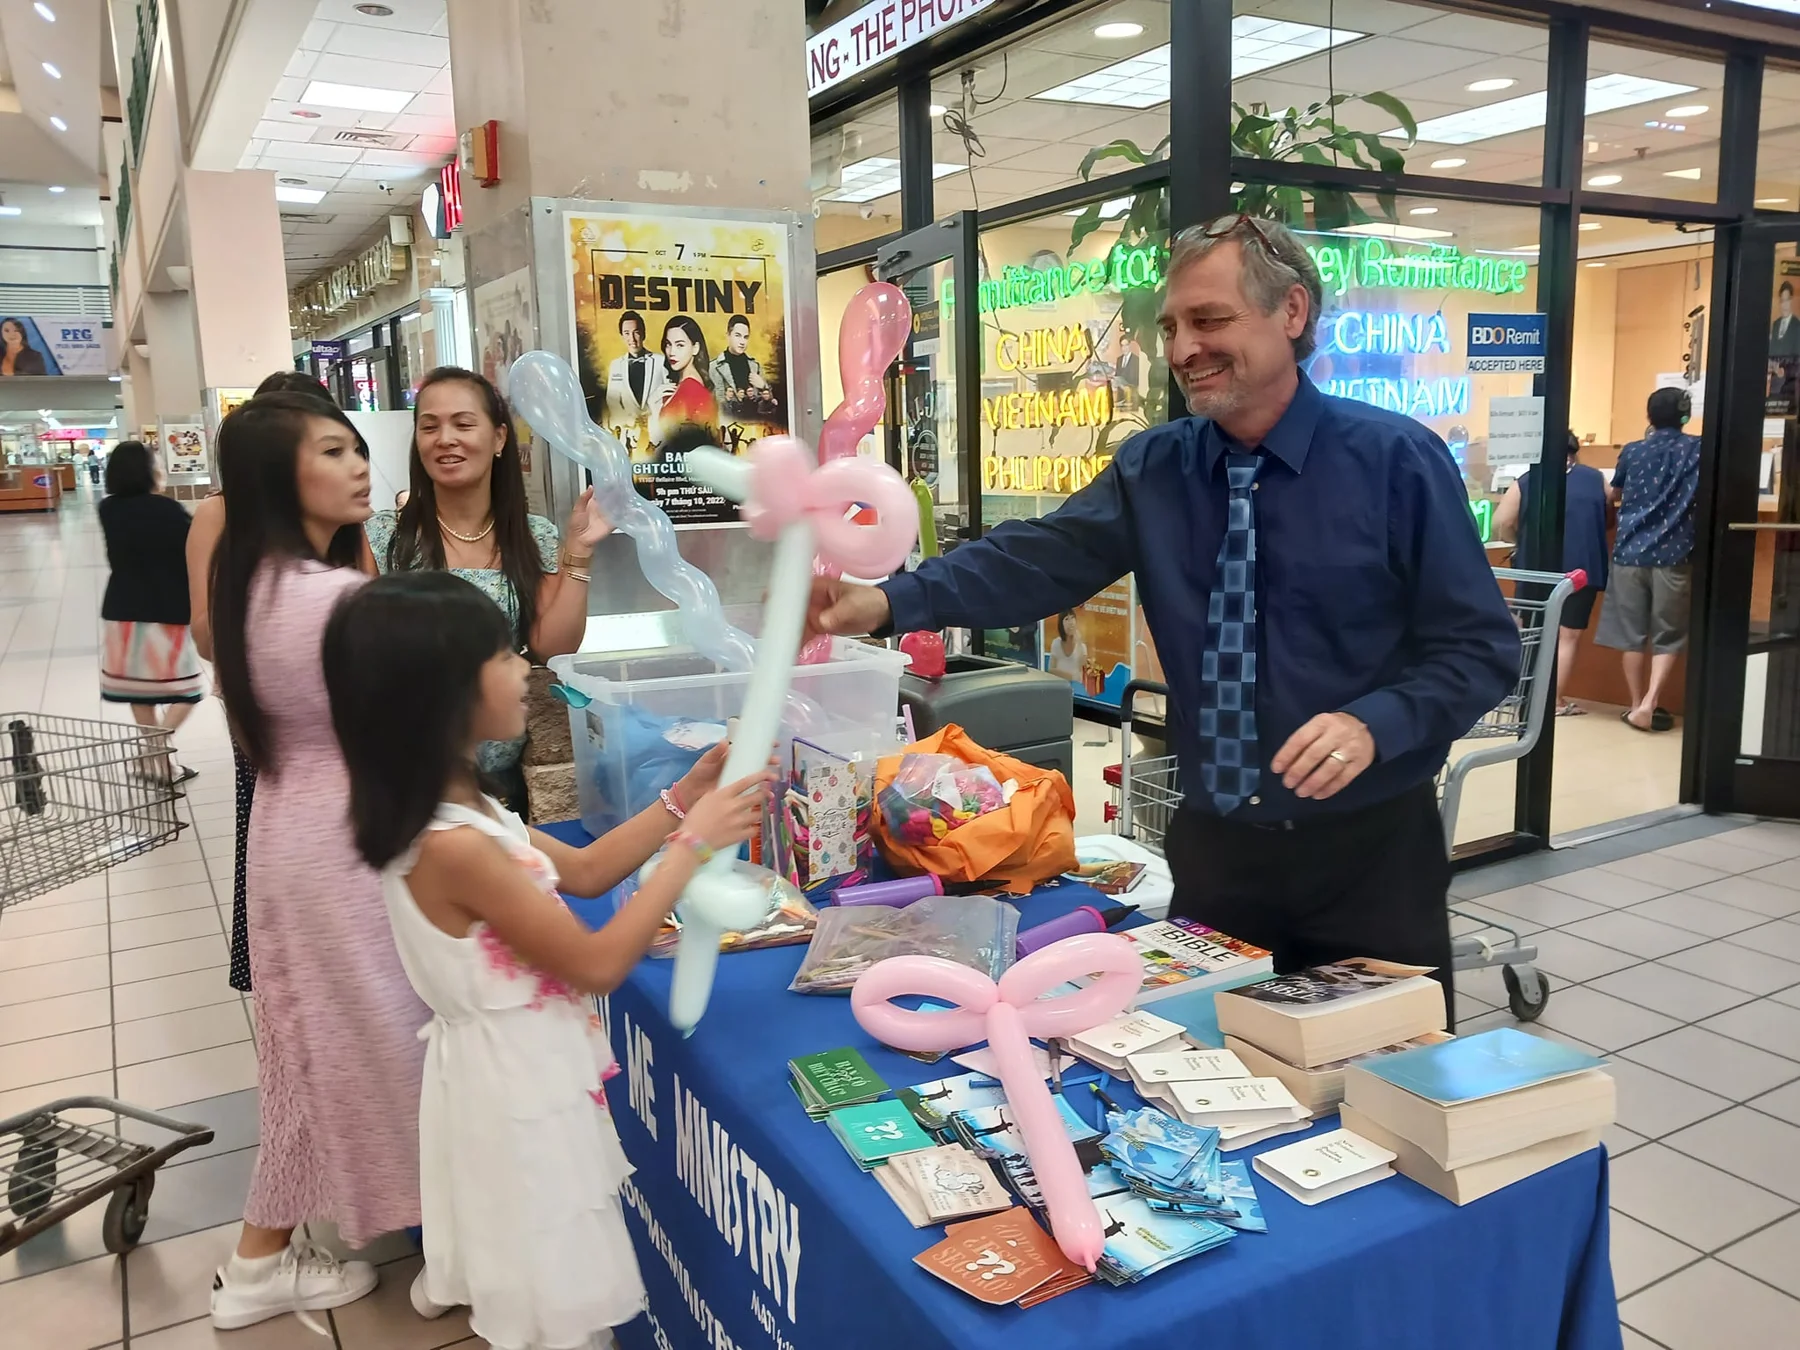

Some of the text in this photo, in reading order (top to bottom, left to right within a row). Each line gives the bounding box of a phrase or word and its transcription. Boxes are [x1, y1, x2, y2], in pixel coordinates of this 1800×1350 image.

[806, 38, 841, 91] NG
[674, 243, 685, 261] 7
[1363, 238, 1528, 294] Remittance
[599, 274, 762, 314] DESTINY
[941, 257, 1106, 319] Rmittance
[996, 322, 1093, 372] CHINA
[1334, 311, 1450, 354] CHINA
[1471, 327, 1541, 346] BDO Remit
[1468, 359, 1543, 372] ACCEPTED HERE
[983, 386, 1112, 430] VIETNAM
[633, 463, 692, 474] GHTCLUB
[1162, 929, 1239, 962] BIBLE
[624, 1012, 801, 1325] ME MINISTRY
